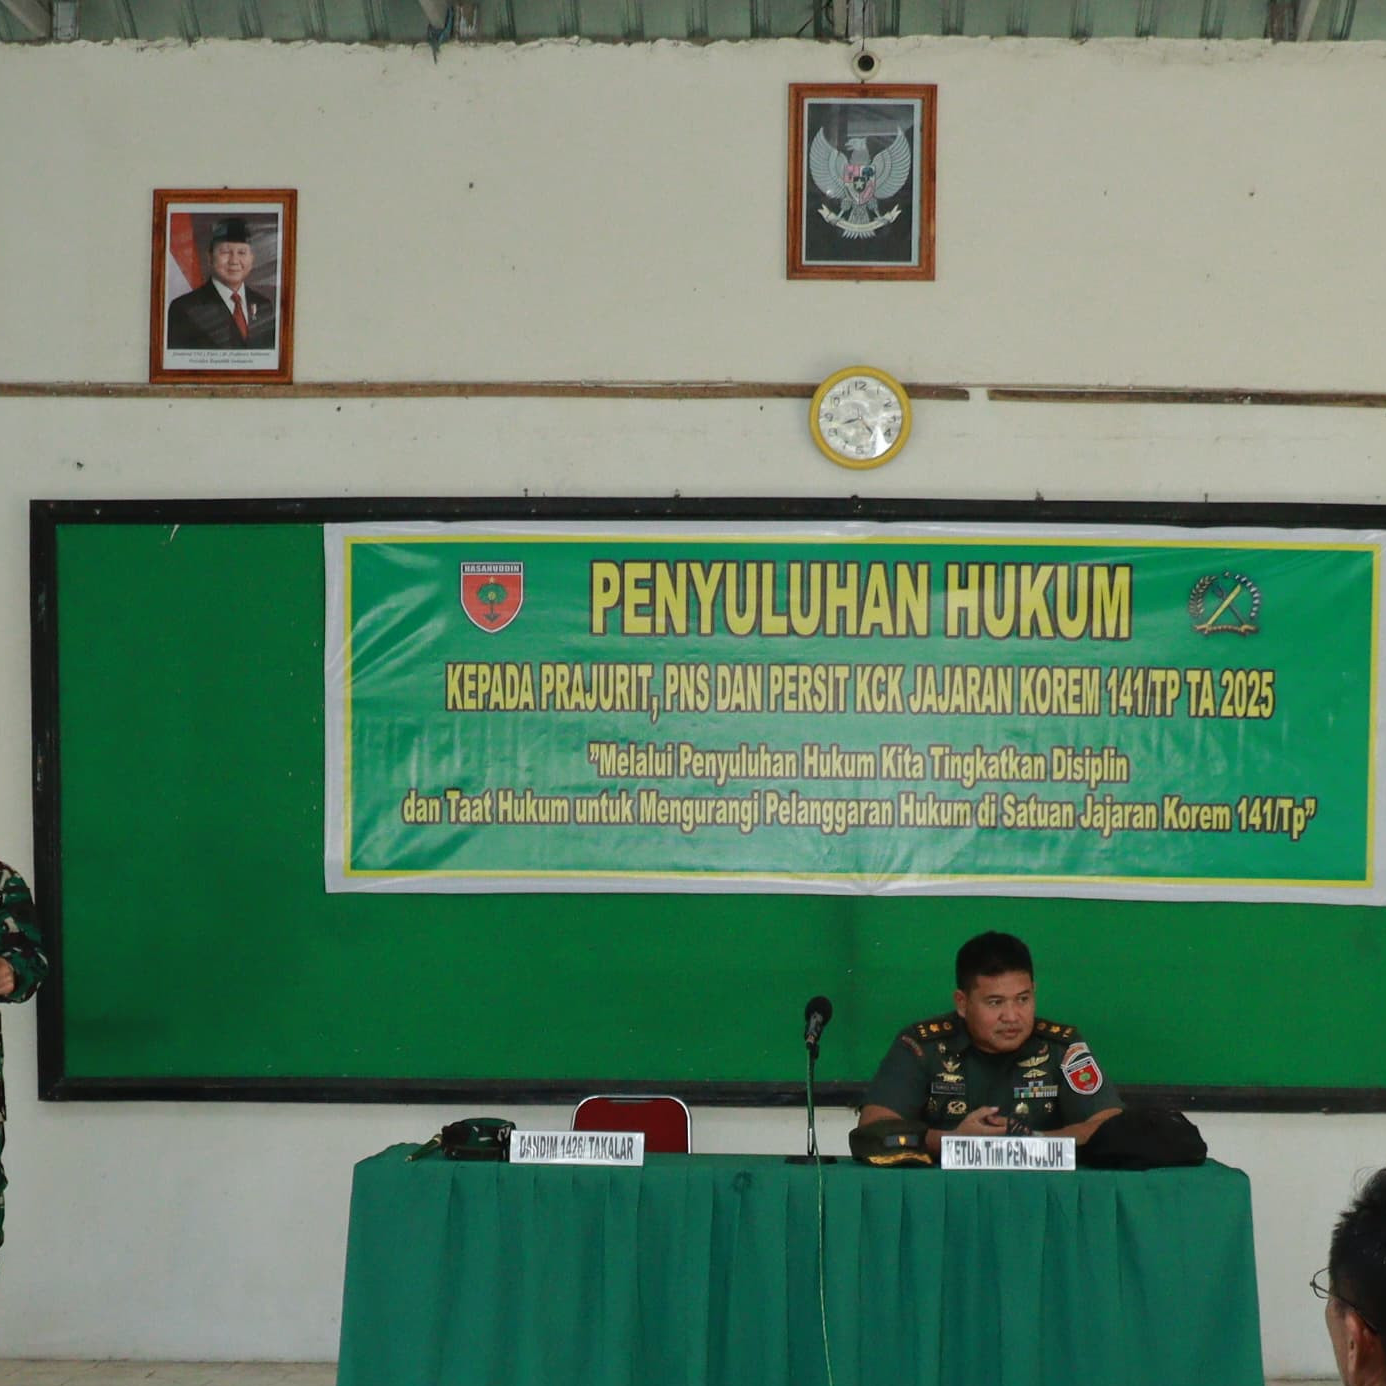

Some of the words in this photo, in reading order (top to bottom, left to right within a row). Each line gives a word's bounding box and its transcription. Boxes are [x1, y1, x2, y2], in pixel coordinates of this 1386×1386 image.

[464, 565, 519, 573] HASANUDDIN
[591, 560, 930, 637] PENYULUHAN
[945, 562, 1132, 639] HUKUM
[445, 663, 535, 711] KEPADA
[540, 663, 659, 722] PRAJURIT,
[665, 663, 710, 712] PNS
[716, 664, 762, 712] DAN
[768, 664, 851, 713] PERSIT
[855, 664, 905, 713] KCK
[909, 665, 1013, 714] JAJARAN
[1018, 666, 1101, 715] KOREM
[1106, 667, 1181, 717] 141/TP
[1185, 669, 1215, 717] TA
[1220, 669, 1275, 718] 2025
[678, 742, 798, 786] Penyuluhan
[802, 743, 876, 779] Hukum
[880, 744, 924, 780] Kita
[929, 744, 1046, 788] Tingkatkan
[1051, 746, 1130, 790] Disiplin
[402, 789, 441, 824] dan
[445, 789, 493, 824] Taat
[497, 790, 569, 824] Hukum
[574, 790, 634, 824] untuk
[638, 790, 760, 833] Mengurangi
[764, 791, 893, 834] Pelanggaran
[898, 792, 972, 827] Hukum
[977, 793, 997, 828] di
[1001, 793, 1075, 829] Satuan
[1079, 795, 1158, 838] Jajaran
[1162, 796, 1232, 831] Korem
[519, 1135, 558, 1158] DANDIM
[589, 1137, 634, 1160] TAKALAR
